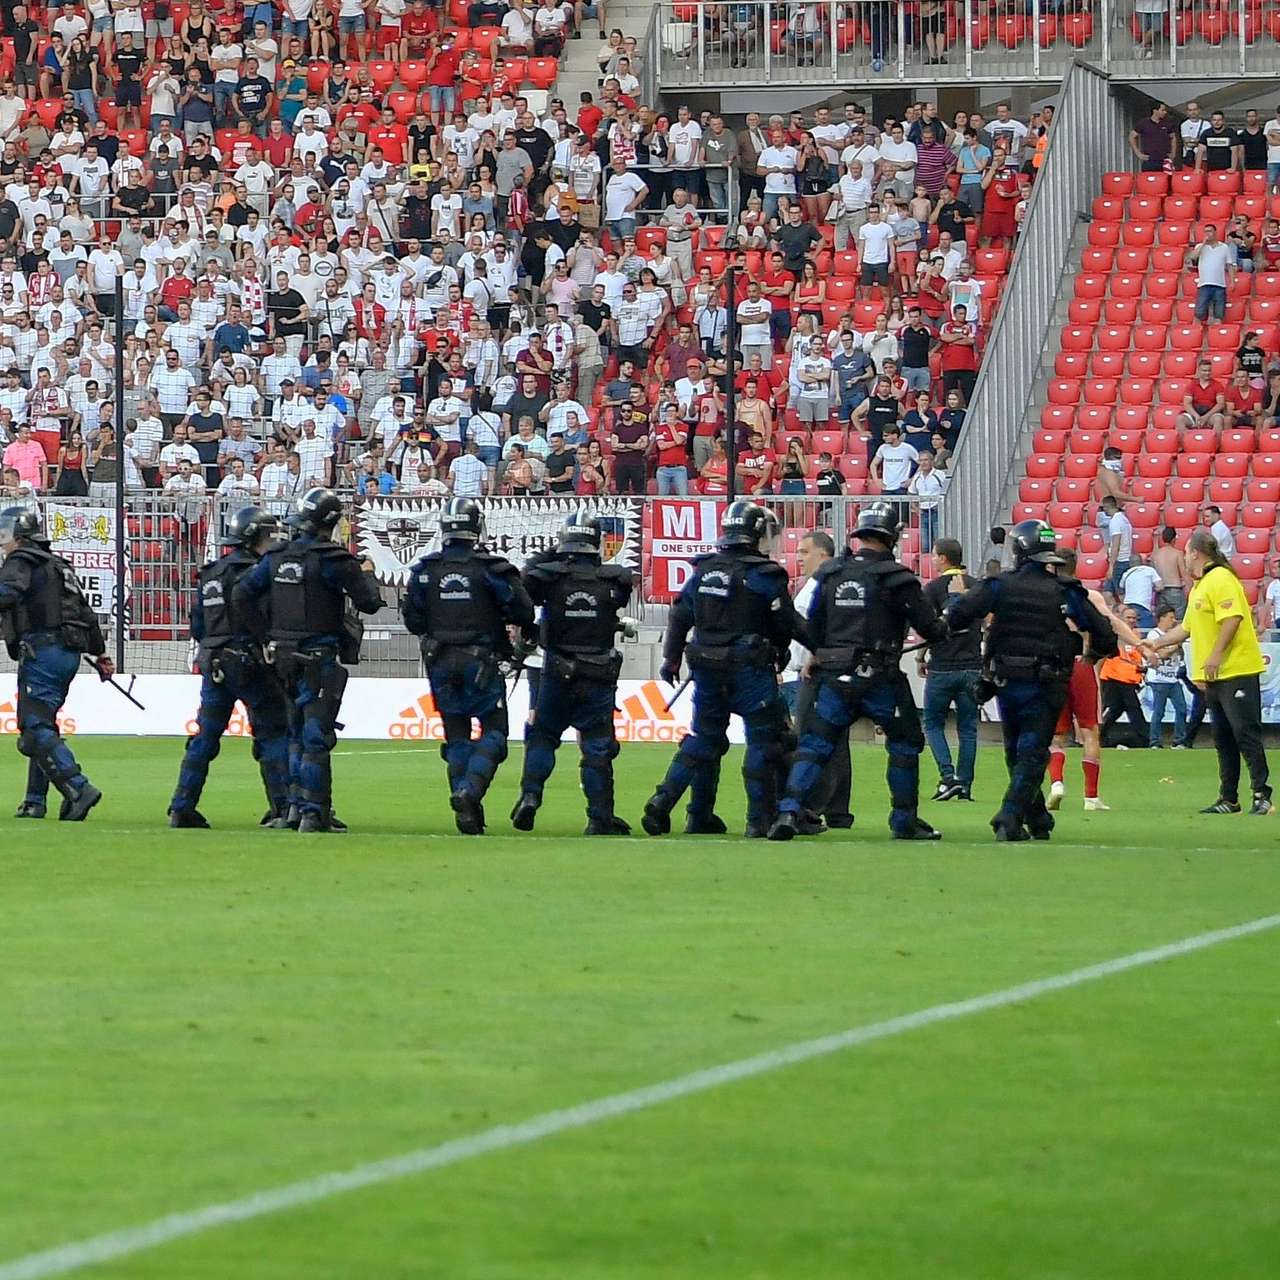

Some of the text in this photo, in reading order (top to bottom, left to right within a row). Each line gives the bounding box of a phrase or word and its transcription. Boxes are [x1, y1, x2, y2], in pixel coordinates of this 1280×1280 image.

[662, 505, 696, 538] M
[661, 544, 683, 553] ONE
[686, 544, 713, 553] STEP
[668, 560, 693, 592] D
